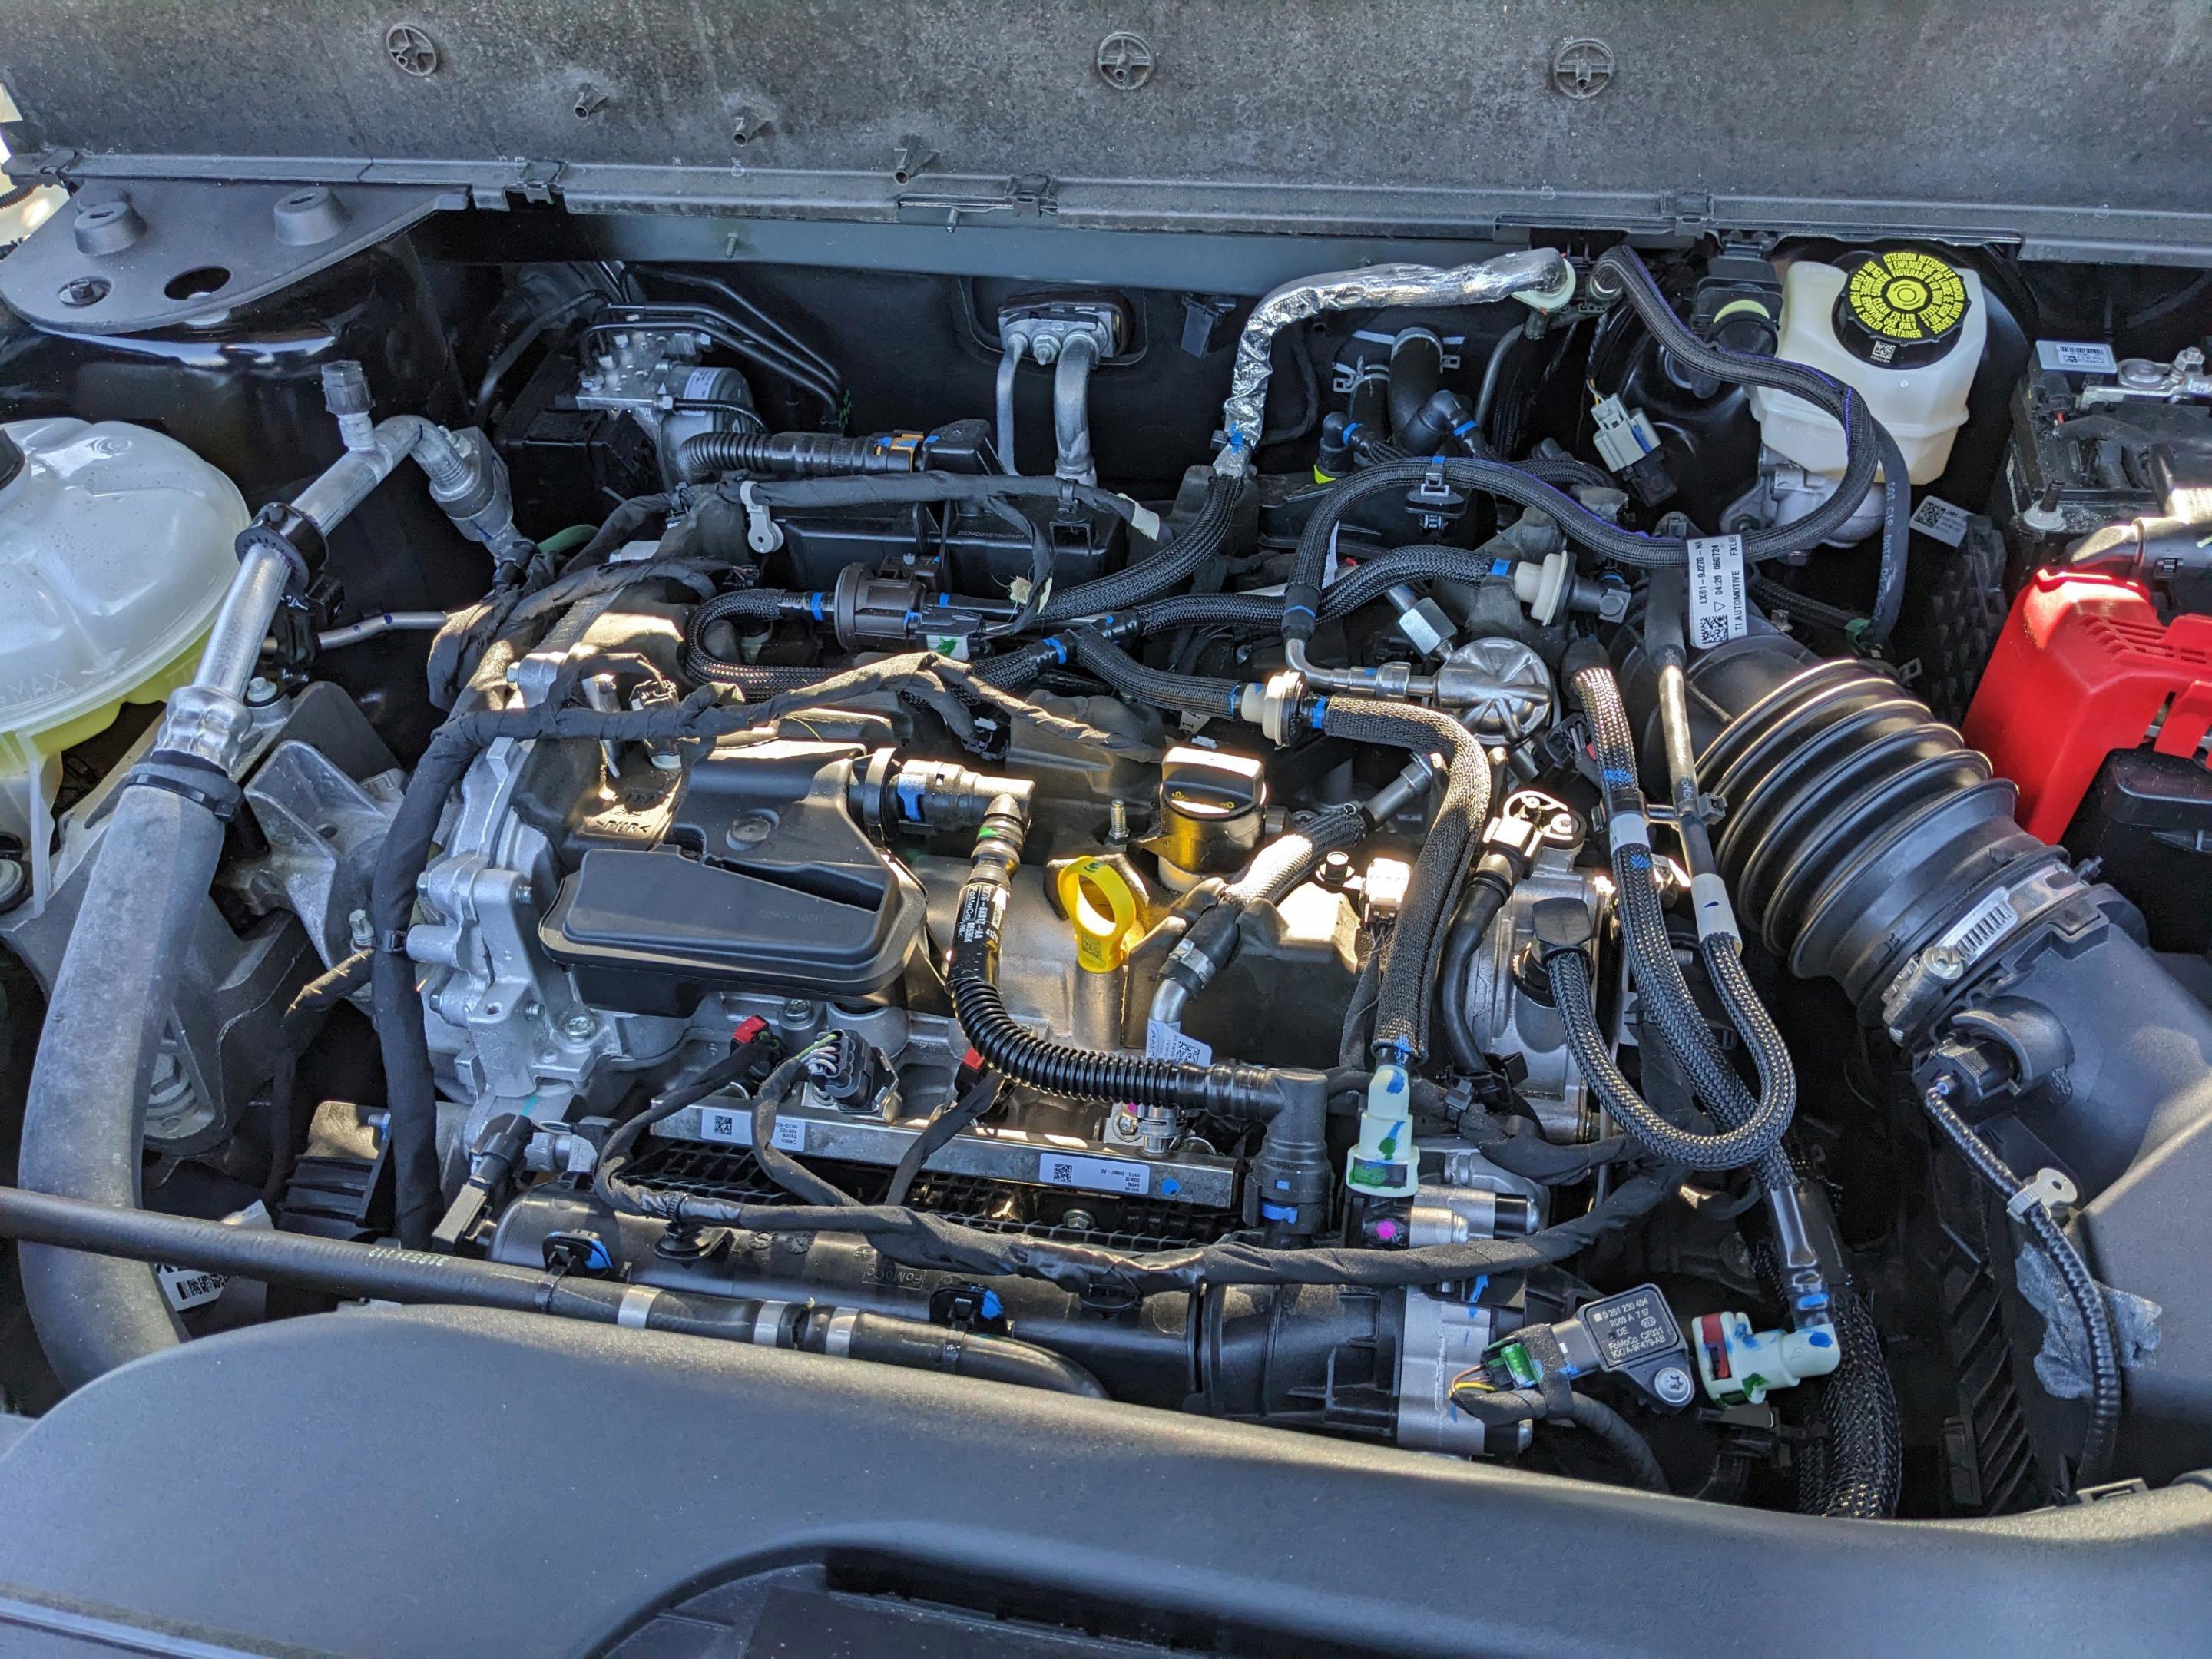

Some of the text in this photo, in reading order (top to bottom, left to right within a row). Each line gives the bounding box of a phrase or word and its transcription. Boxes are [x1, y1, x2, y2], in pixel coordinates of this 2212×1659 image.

[1883, 252, 1917, 263] ATTENTION
[1849, 292, 1863, 307] FROM
[1859, 311, 1883, 330] SEALED
[1883, 326, 1922, 338] CONTAINER
[1860, 296, 1886, 322] REMOVING
[1882, 317, 1898, 329] USE
[1898, 322, 1919, 332] ONLY
[1872, 297, 1891, 316] CLEAN
[1889, 311, 1916, 323] FILLER
[1711, 544, 1724, 595] 04:20 060724
[1730, 571, 1743, 622] AUTOMOTIVE
[6, 668, 70, 704] MAX
[965, 886, 978, 919] FoMoCo
[866, 1267, 923, 1284] FoMoCo
[1608, 1336, 1639, 1351] FoMoCo
[1616, 1326, 1630, 1336] DE
